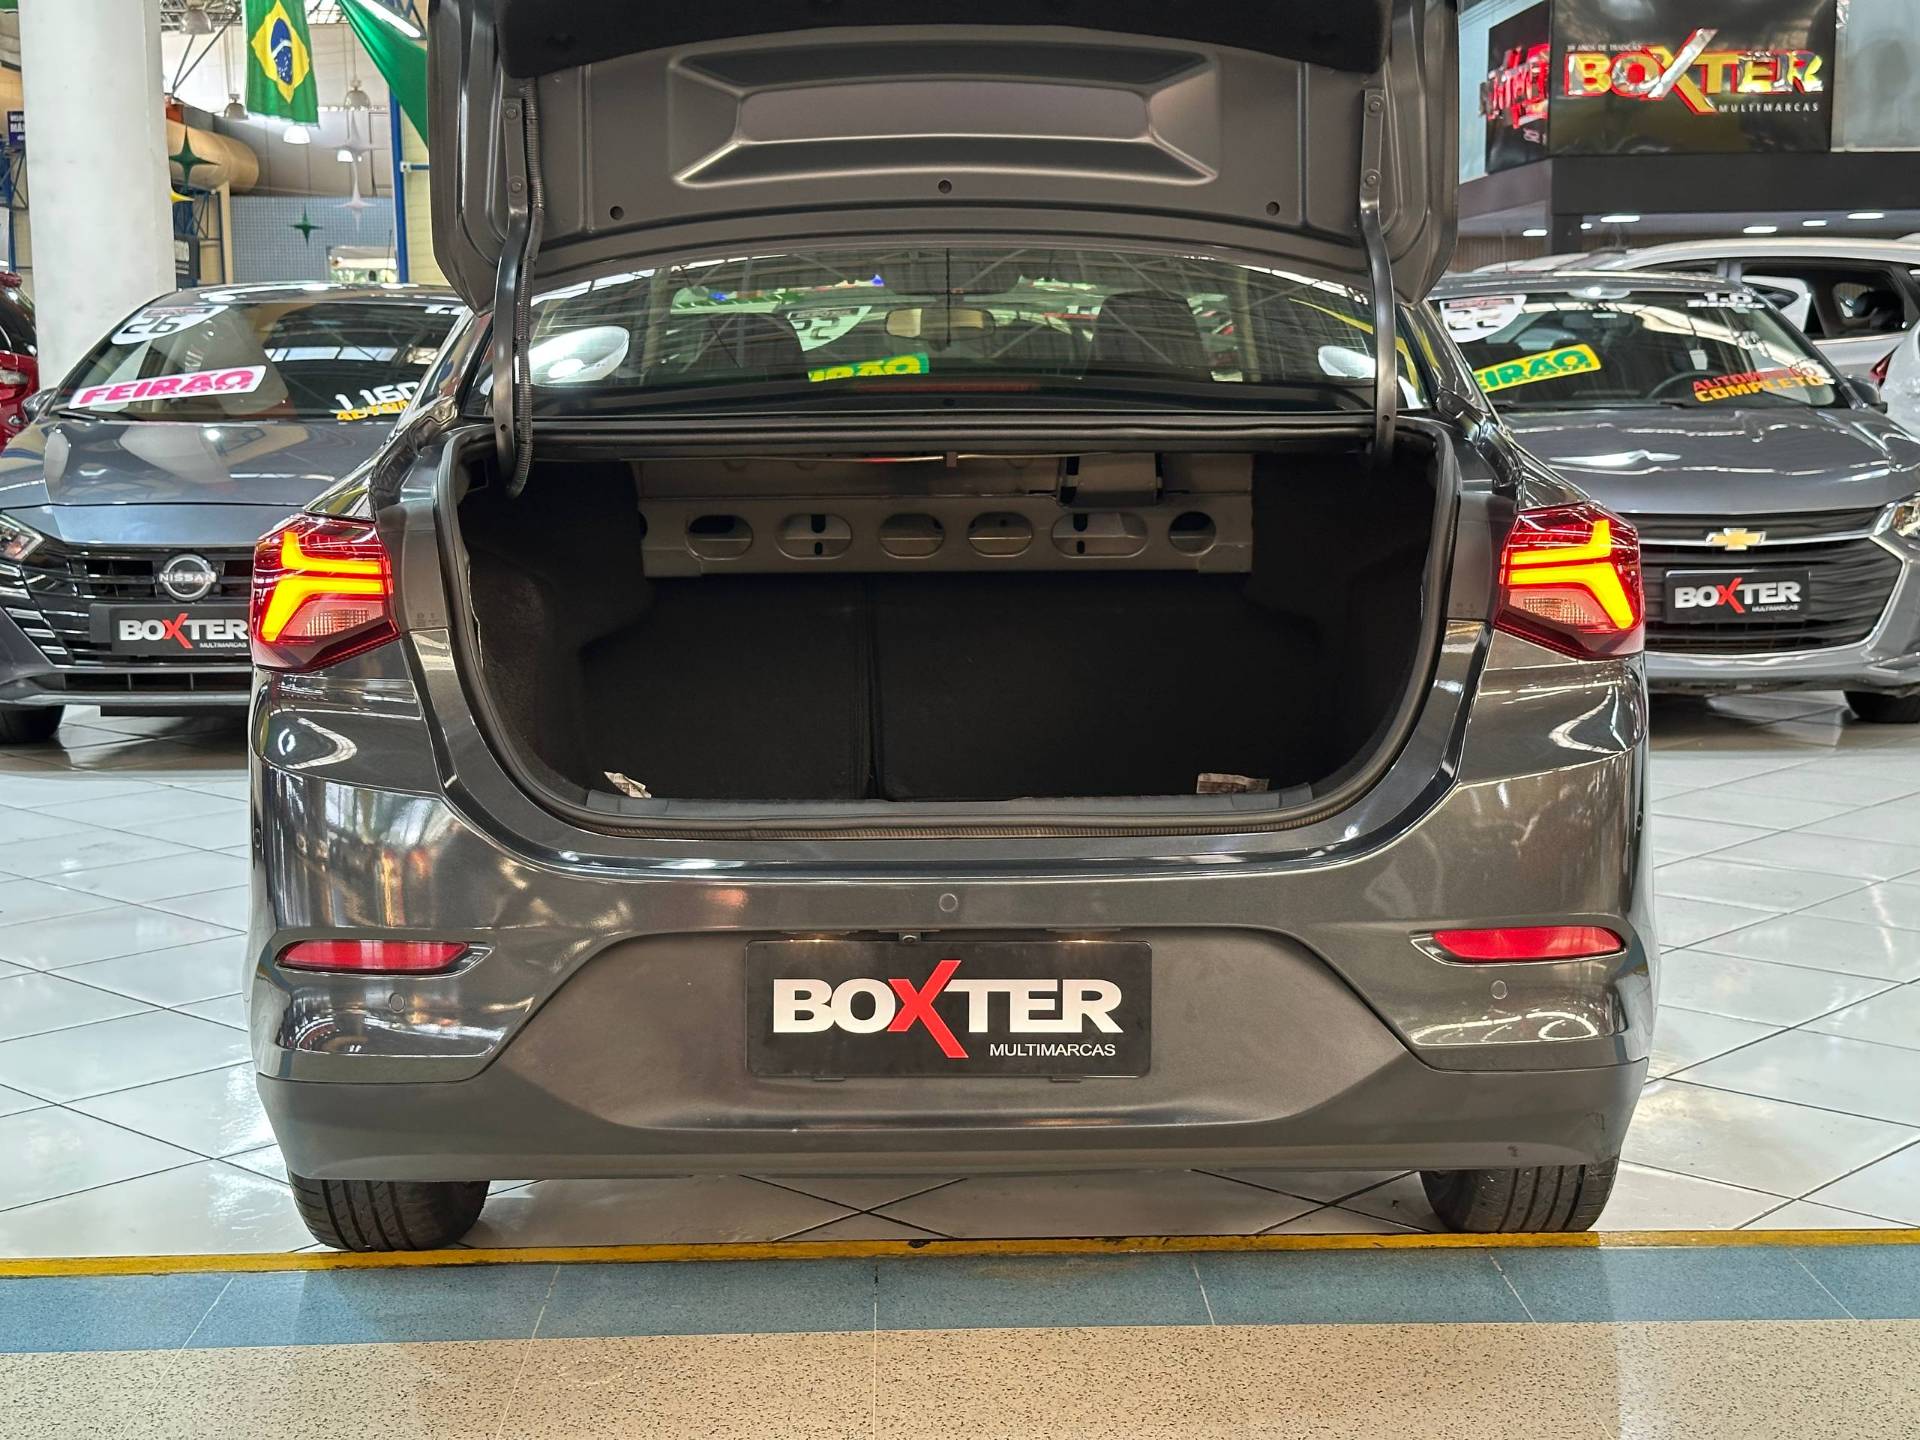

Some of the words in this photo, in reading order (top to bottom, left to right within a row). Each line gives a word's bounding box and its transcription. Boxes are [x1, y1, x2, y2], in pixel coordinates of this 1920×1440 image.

[1564, 28, 1824, 116] BOXTER
[1718, 102, 1820, 113] MULTIMARCAS
[79, 370, 255, 405] FEIRÃO
[1694, 374, 1826, 403] COMPLETO
[158, 571, 217, 584] NISSAN
[1674, 577, 1802, 614] BOXTER
[119, 612, 249, 649] BOXTER
[772, 959, 1124, 1059] BOXTER
[988, 1043, 1117, 1057] MULTIMARCAS
